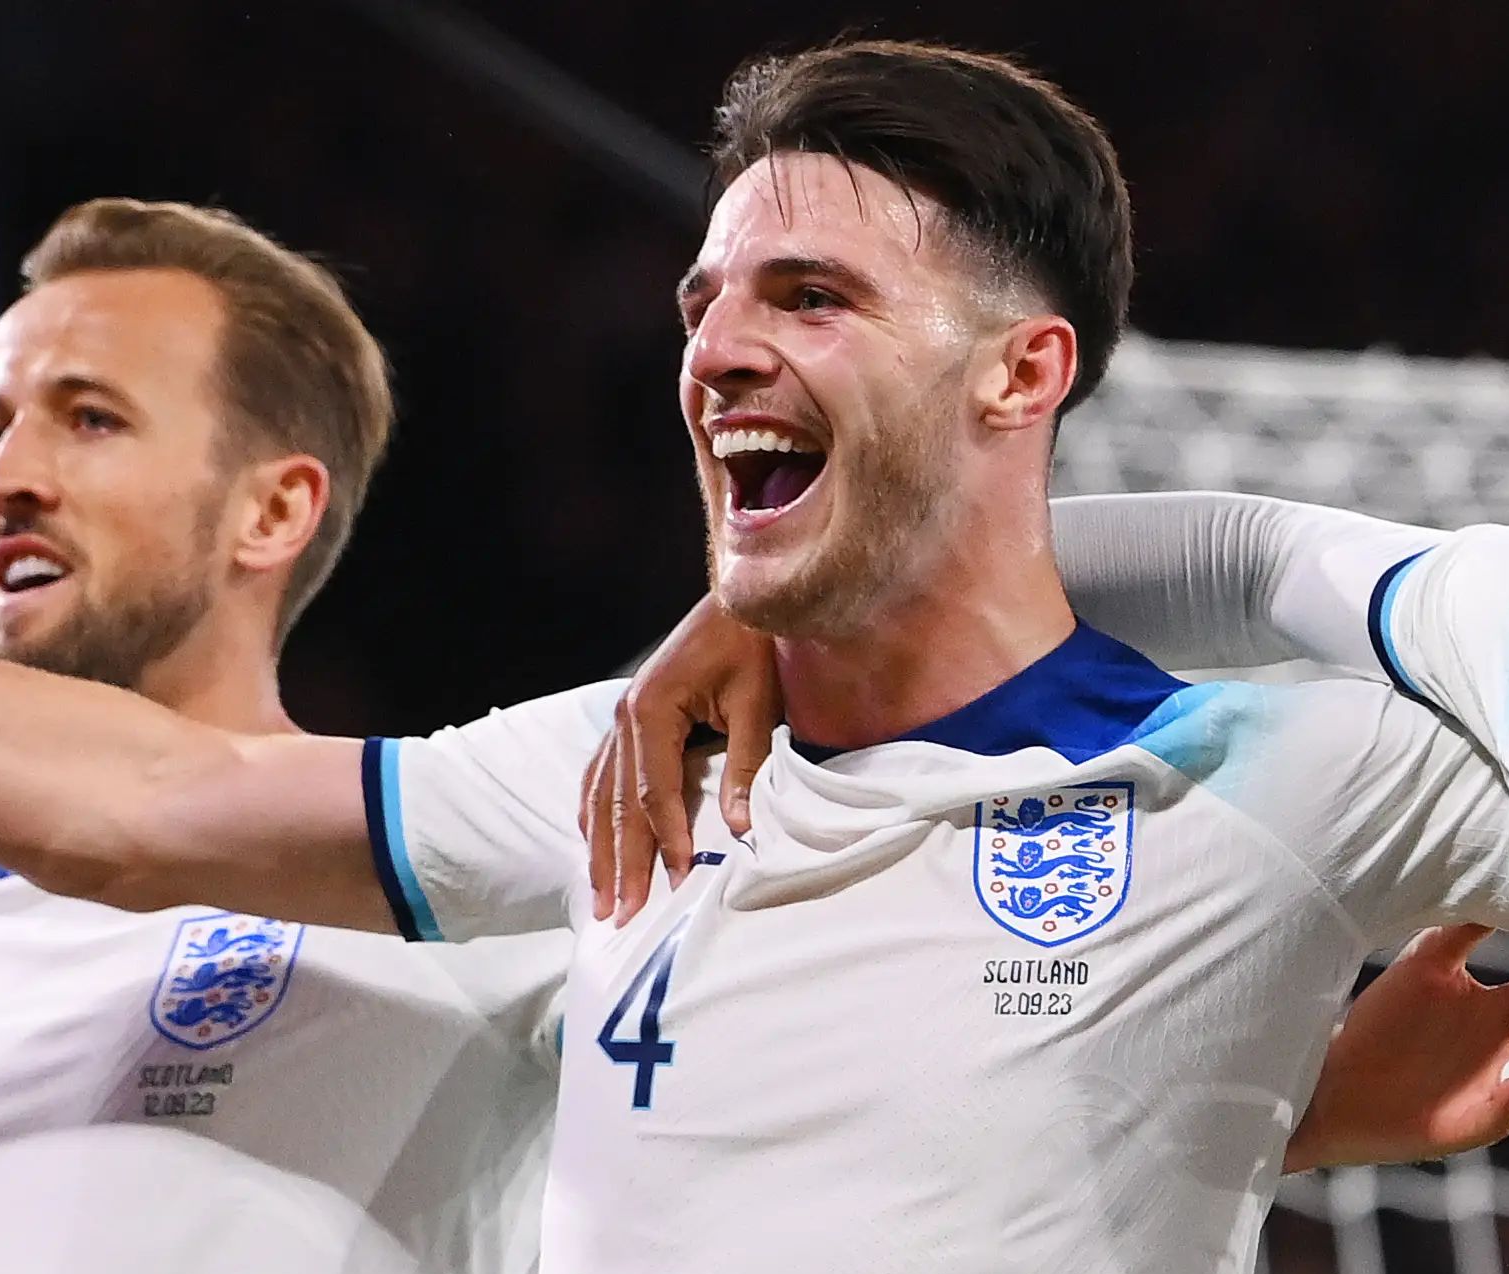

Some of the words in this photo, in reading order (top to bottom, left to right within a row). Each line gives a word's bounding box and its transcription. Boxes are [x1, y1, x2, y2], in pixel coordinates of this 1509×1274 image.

[983, 960, 1089, 985] SCOTLAND
[596, 912, 691, 1110] 4
[993, 992, 1072, 1015] 12.09.23
